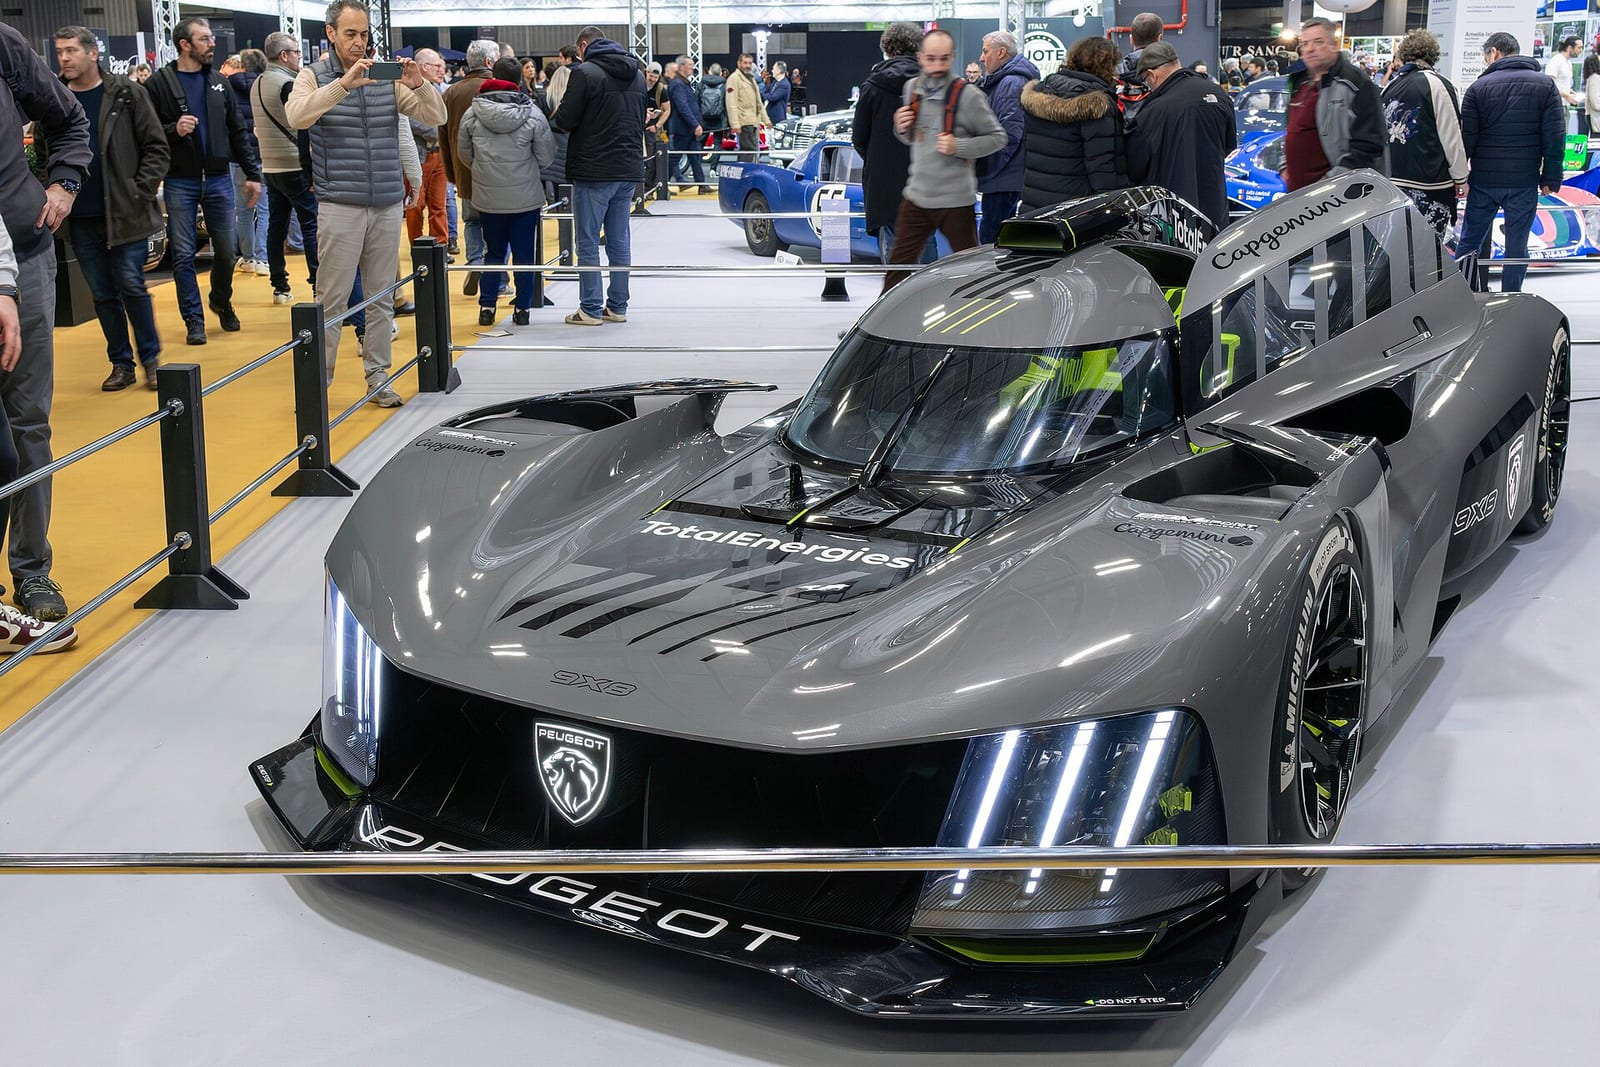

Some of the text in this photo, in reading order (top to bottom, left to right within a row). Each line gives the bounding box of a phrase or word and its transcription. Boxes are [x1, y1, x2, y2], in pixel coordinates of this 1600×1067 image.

[1027, 22, 1048, 30] ITALY
[1211, 194, 1345, 270] Capgemini
[415, 439, 490, 456] Capgemini
[1453, 488, 1499, 536] 9X8
[640, 520, 916, 569] TotalEnergies
[1113, 522, 1227, 544] Capgemini
[1285, 587, 1315, 734] MICHELIN
[550, 669, 638, 697] 9X8
[538, 727, 605, 751] PEUGEOT
[363, 825, 800, 952] PGEOT
